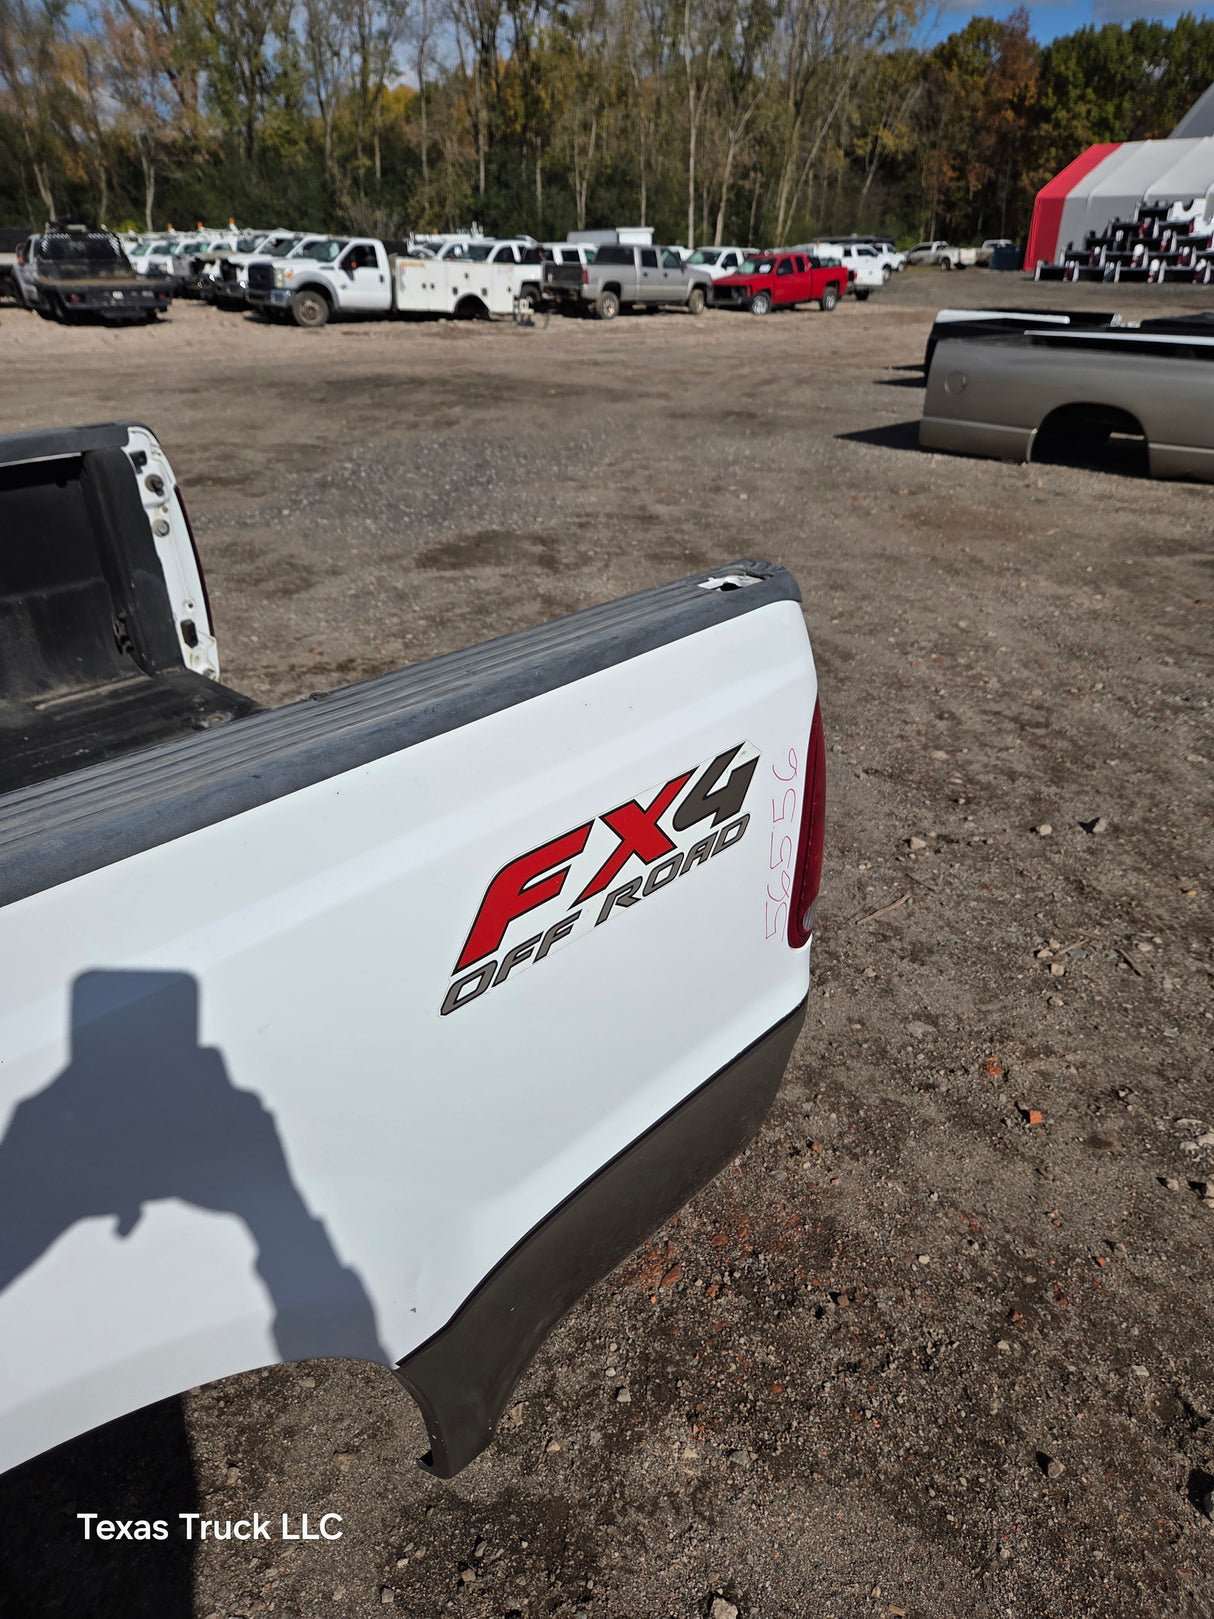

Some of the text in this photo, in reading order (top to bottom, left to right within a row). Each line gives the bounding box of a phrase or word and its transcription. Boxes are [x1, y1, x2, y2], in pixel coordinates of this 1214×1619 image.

[440, 813, 750, 1016] OFF ROAD
[451, 741, 760, 976] FX4
[765, 747, 799, 942] 56556
